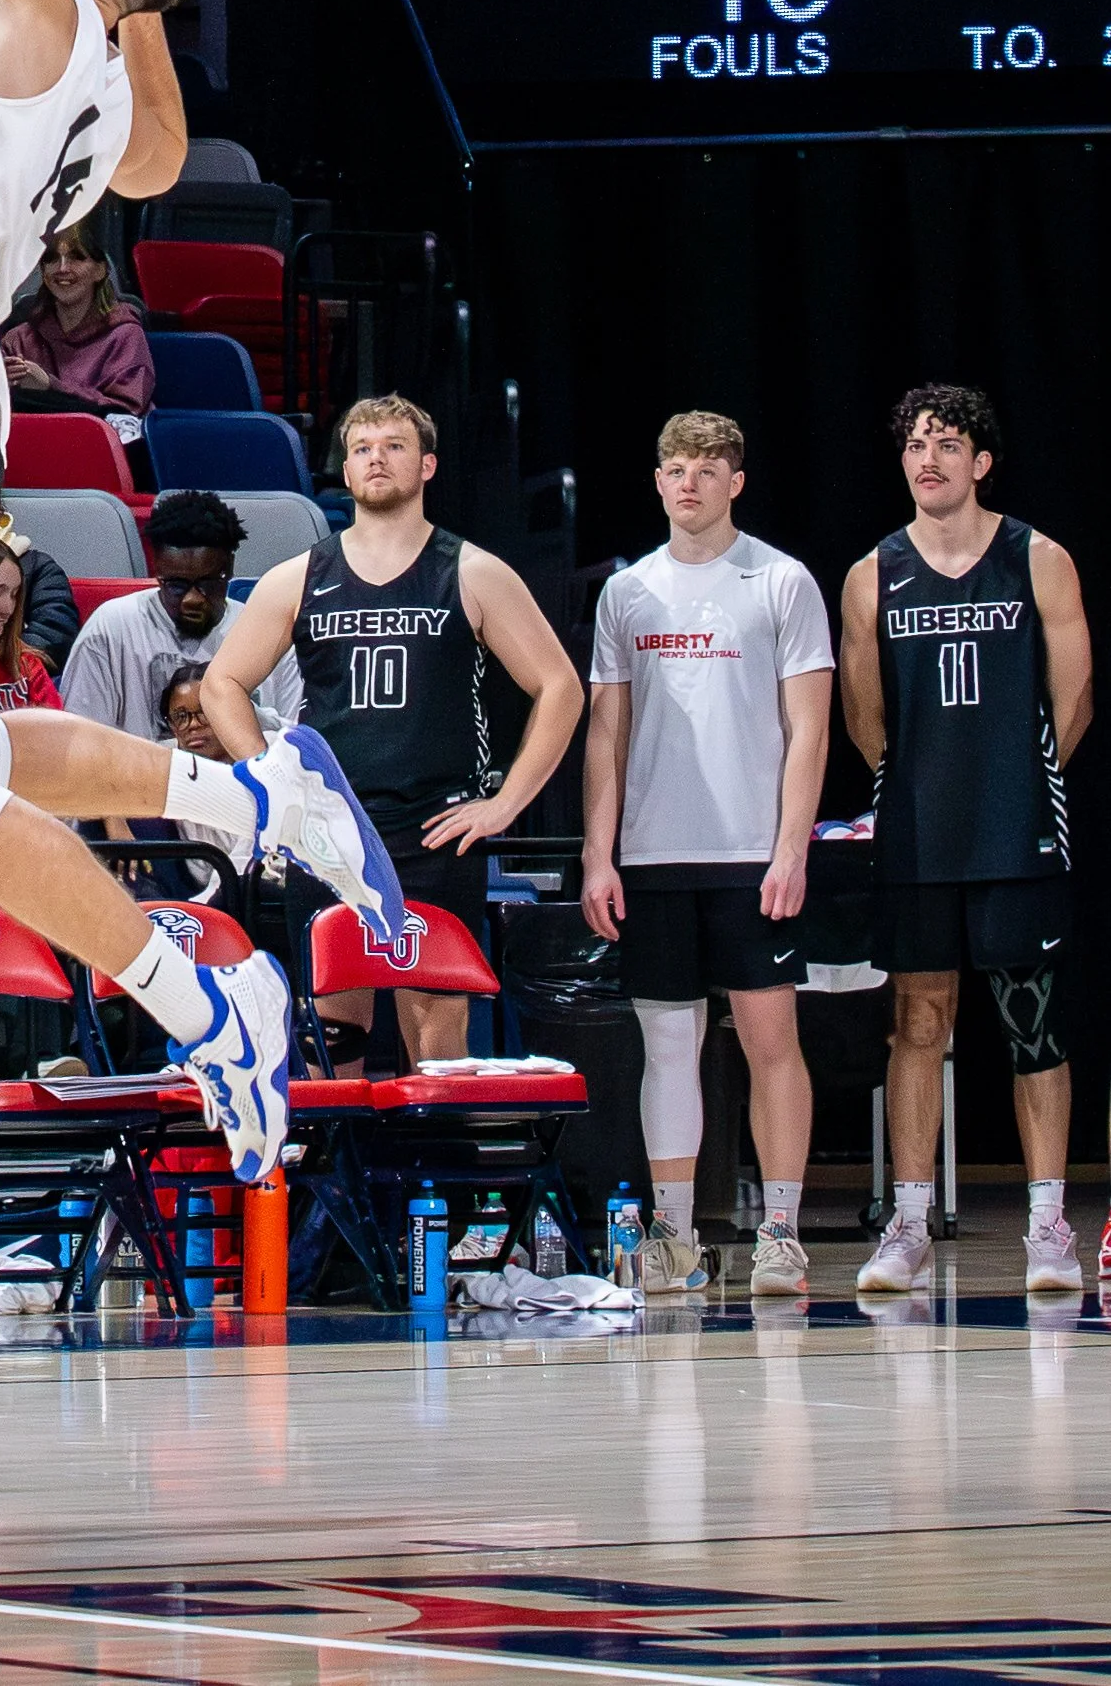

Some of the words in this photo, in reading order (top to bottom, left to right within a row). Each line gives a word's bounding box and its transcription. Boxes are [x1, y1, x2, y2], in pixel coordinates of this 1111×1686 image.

[651, 32, 830, 80] FOULS
[961, 25, 1057, 71] T.O.
[310, 608, 450, 641] LIBERTY
[635, 633, 714, 651] LIBERTY
[887, 601, 1023, 638] LIBERTY
[350, 645, 407, 709] 10
[689, 650, 742, 659] VOLLEYBALL
[938, 641, 979, 706] 11
[413, 1216, 424, 1293] POWERADE
